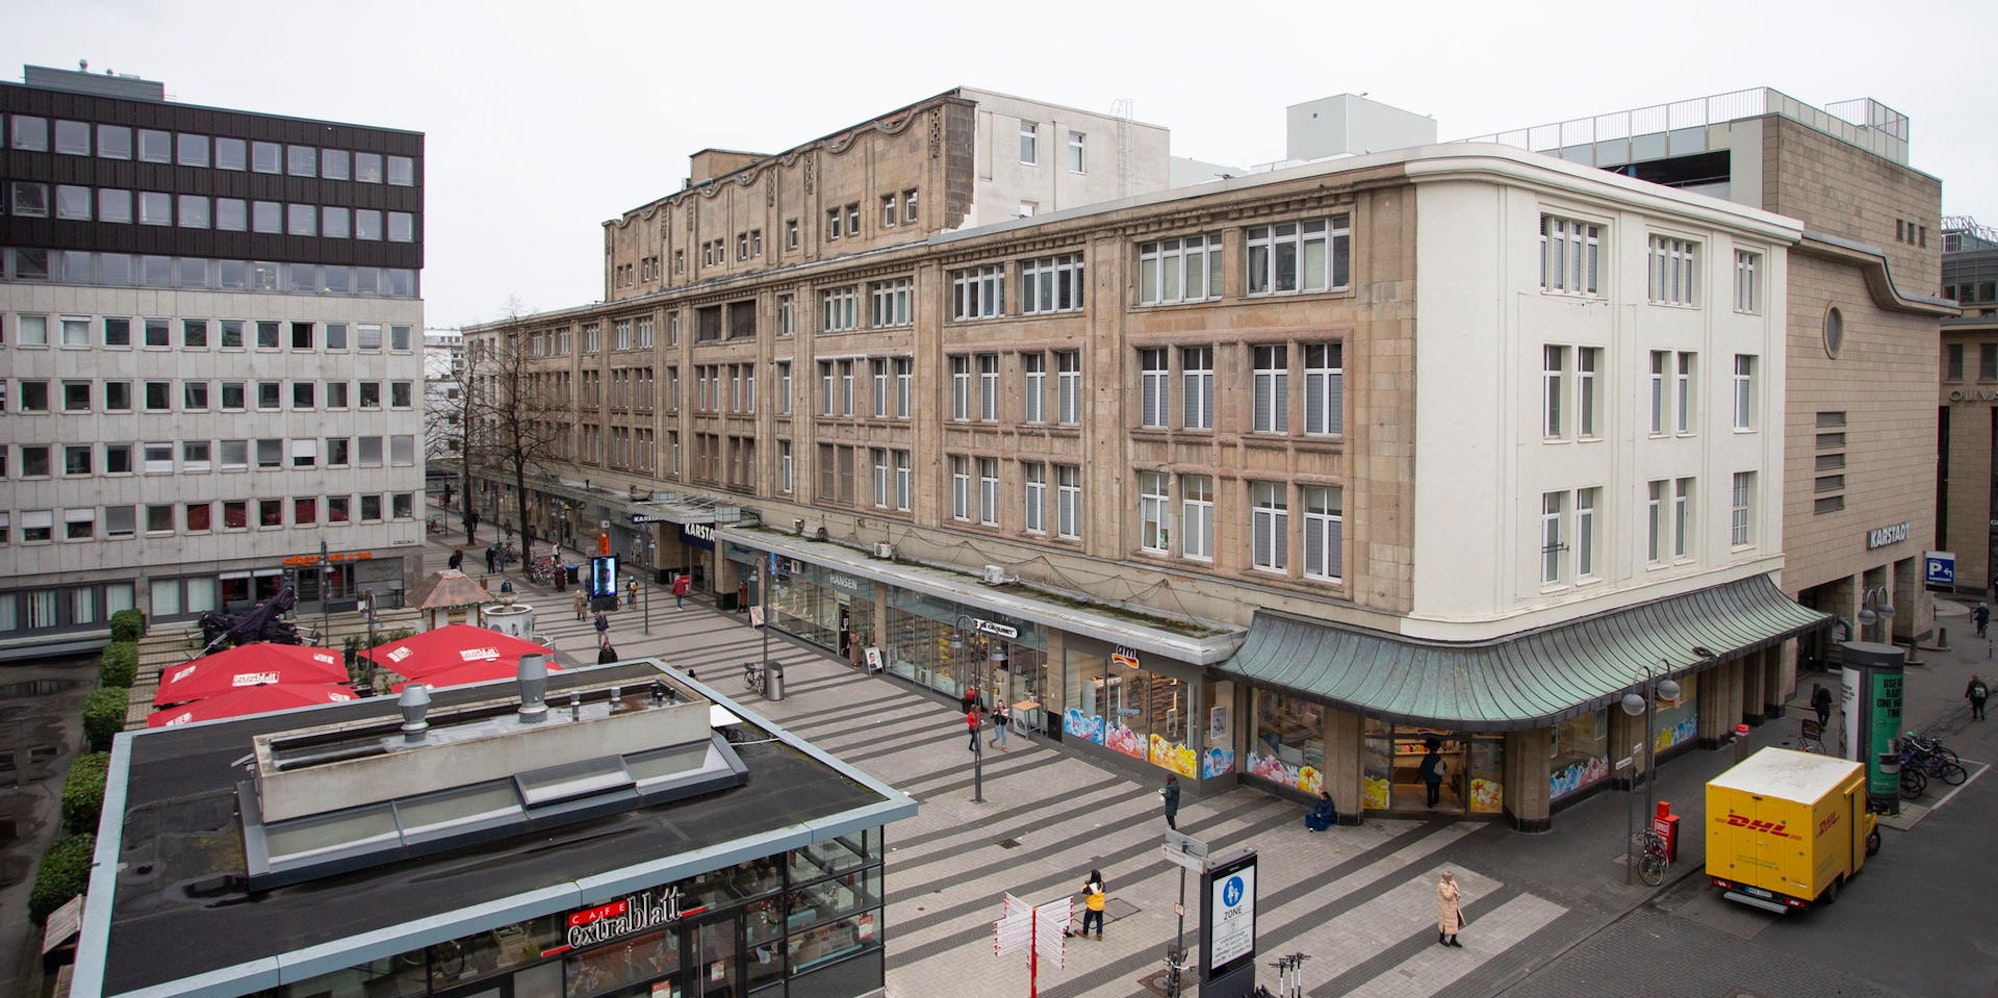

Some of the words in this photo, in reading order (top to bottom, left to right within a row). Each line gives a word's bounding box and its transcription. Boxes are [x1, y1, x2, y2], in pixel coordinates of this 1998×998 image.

[1870, 522, 1910, 548] KARSTADT
[1929, 562, 1943, 576] P
[829, 573, 858, 590] HANSEN
[1883, 679, 1896, 689] USE
[1727, 814, 1790, 837] DHL
[568, 885, 686, 949] extrablatt
[572, 903, 626, 924] CAFE
[1224, 905, 1243, 920] ZONE
